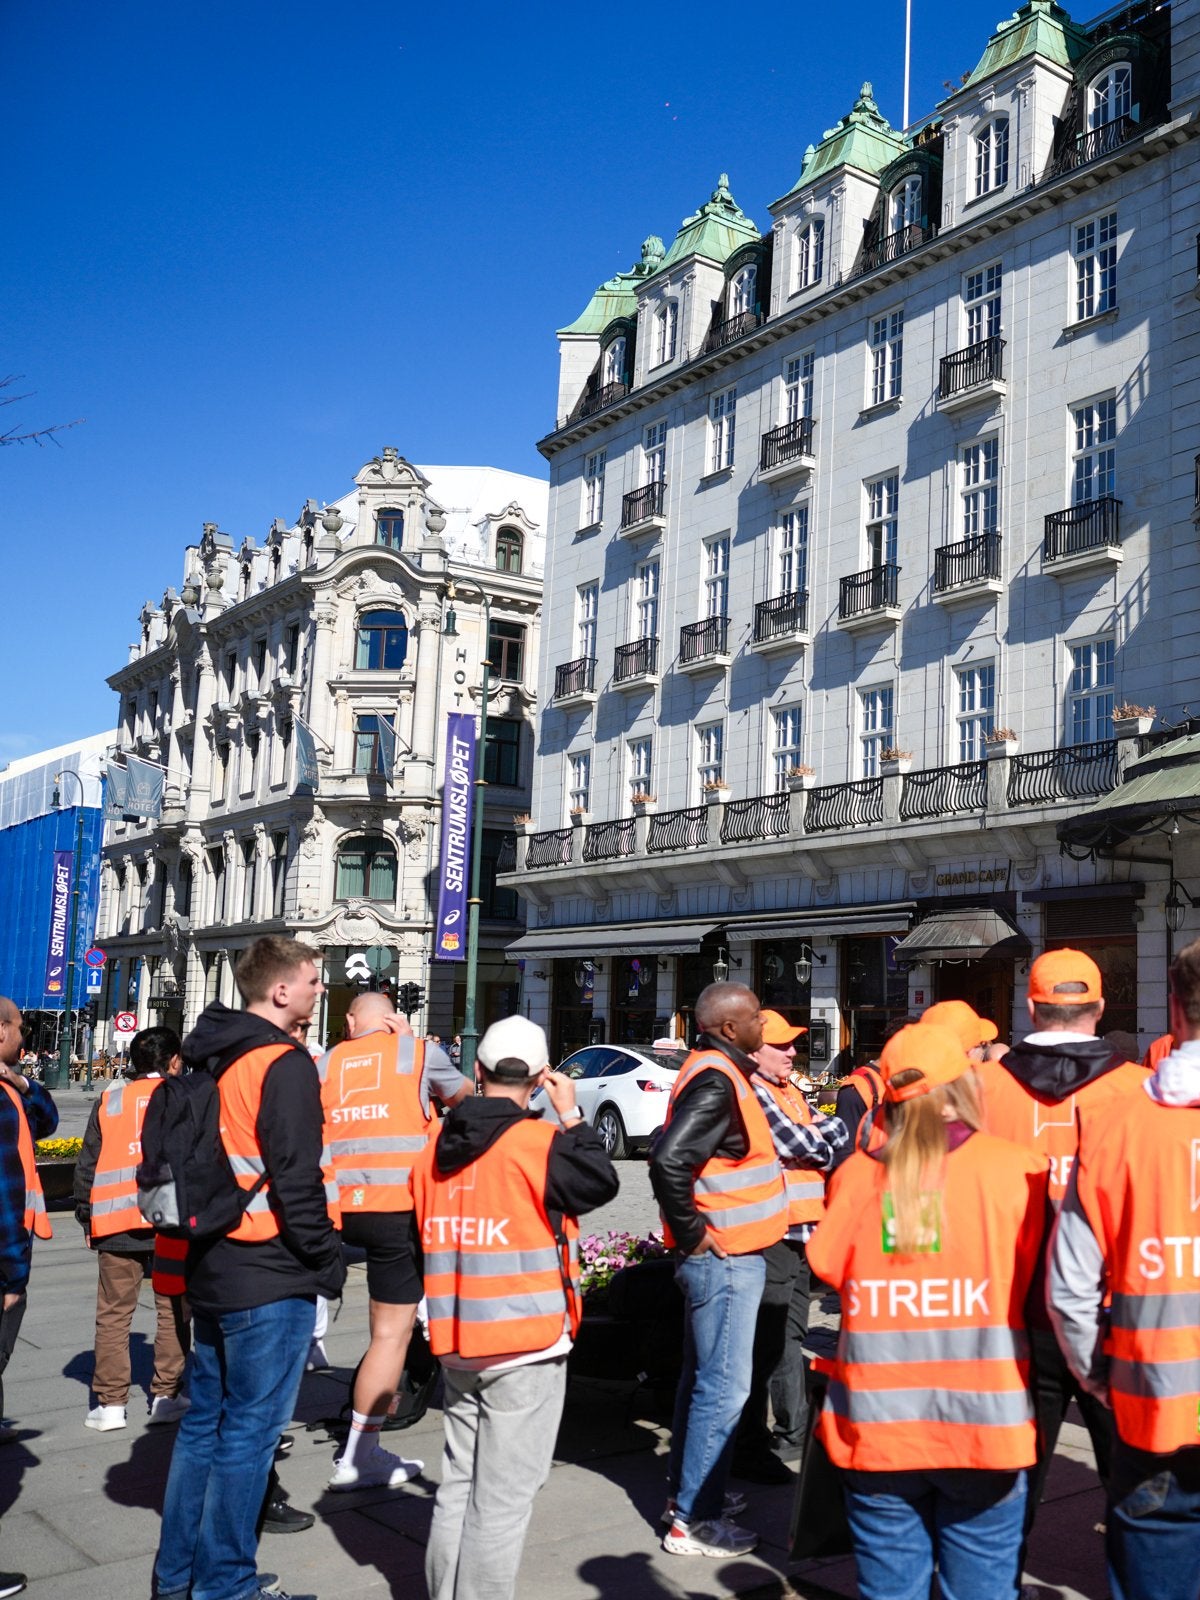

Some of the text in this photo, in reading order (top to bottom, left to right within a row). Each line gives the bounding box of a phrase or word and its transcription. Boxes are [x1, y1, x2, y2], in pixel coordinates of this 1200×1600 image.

[445, 735, 471, 893] SENTRUMSLØPET
[937, 870, 977, 887] GRAND
[51, 863, 69, 957] SENTRUMSLØPET
[345, 1057, 373, 1070] parat
[331, 1103, 390, 1124] STREIK
[848, 1277, 991, 1318] STREIK
